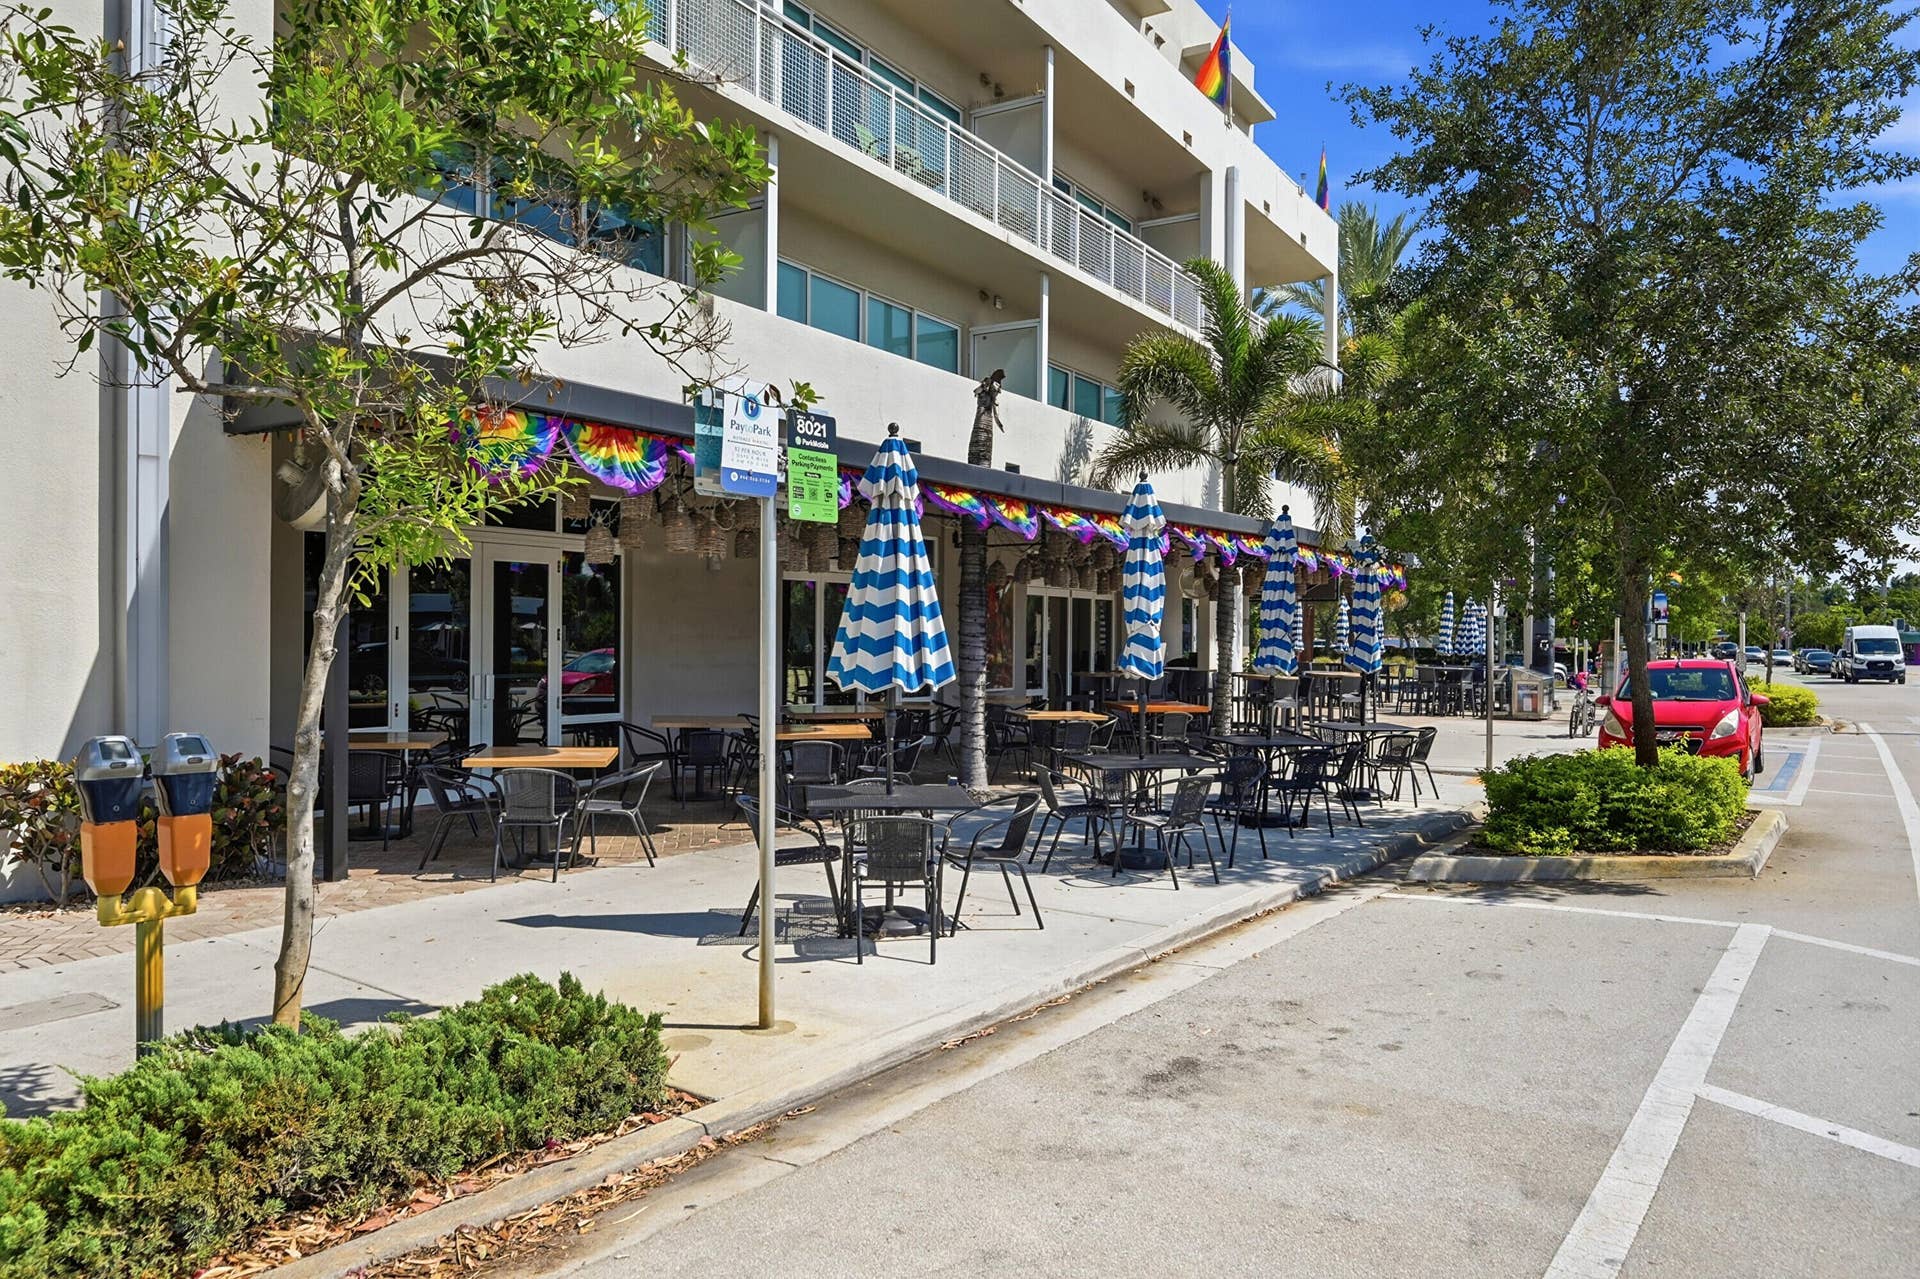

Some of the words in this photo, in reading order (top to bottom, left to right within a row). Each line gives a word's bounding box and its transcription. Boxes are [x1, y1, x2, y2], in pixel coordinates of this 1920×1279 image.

[796, 419, 827, 438] 8021
[802, 438, 829, 449] ParkMobile
[798, 453, 827, 463] Contactless
[791, 459, 810, 470] Parking
[810, 462, 834, 472] Payments
